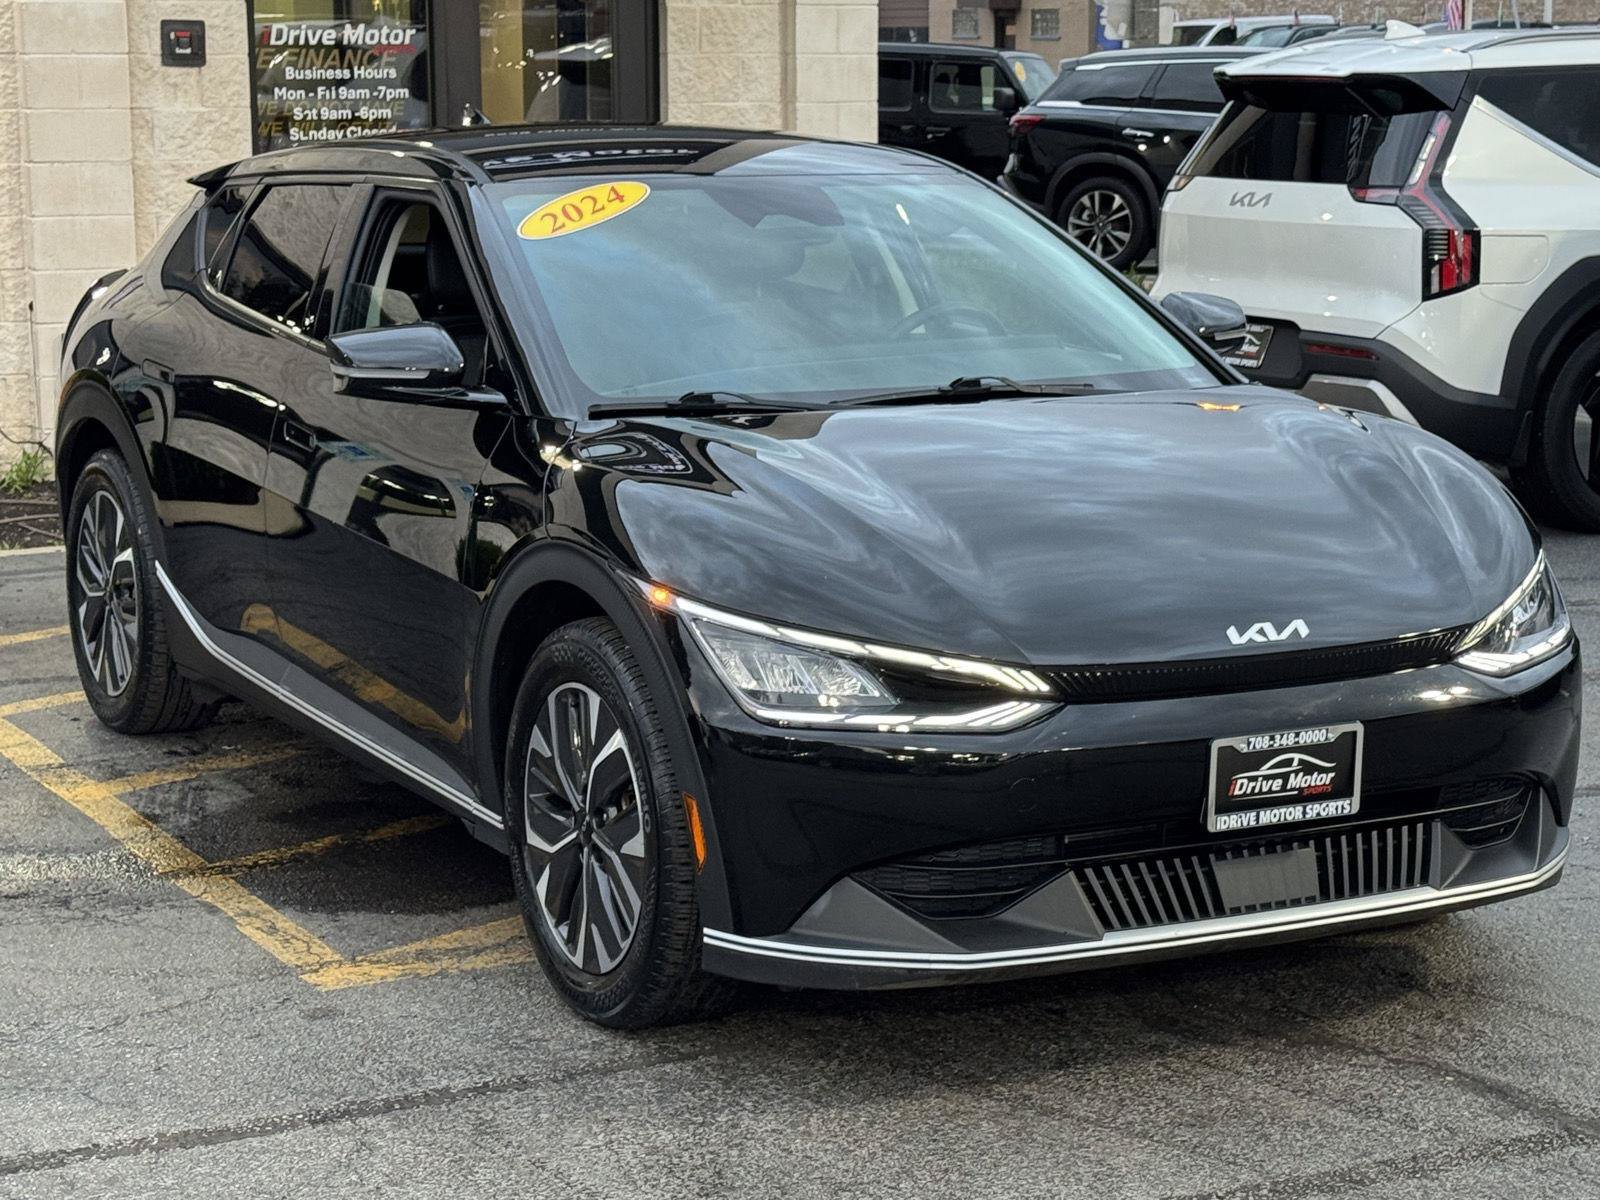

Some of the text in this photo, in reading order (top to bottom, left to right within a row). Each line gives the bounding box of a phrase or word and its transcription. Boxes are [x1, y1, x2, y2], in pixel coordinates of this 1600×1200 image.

[261, 23, 416, 46] iDrive Motor
[285, 65, 398, 81] Business Hours
[273, 86, 306, 101] Mon
[338, 86, 370, 101] 9am
[320, 107, 353, 121] 9am
[540, 185, 625, 234] 2024
[1225, 618, 1310, 645] KIA
[1248, 729, 1328, 750] 708-348-0000
[1228, 771, 1336, 797] iDrive Motor
[1258, 806, 1304, 825] MOTOR
[1304, 799, 1351, 818] SPORTS
